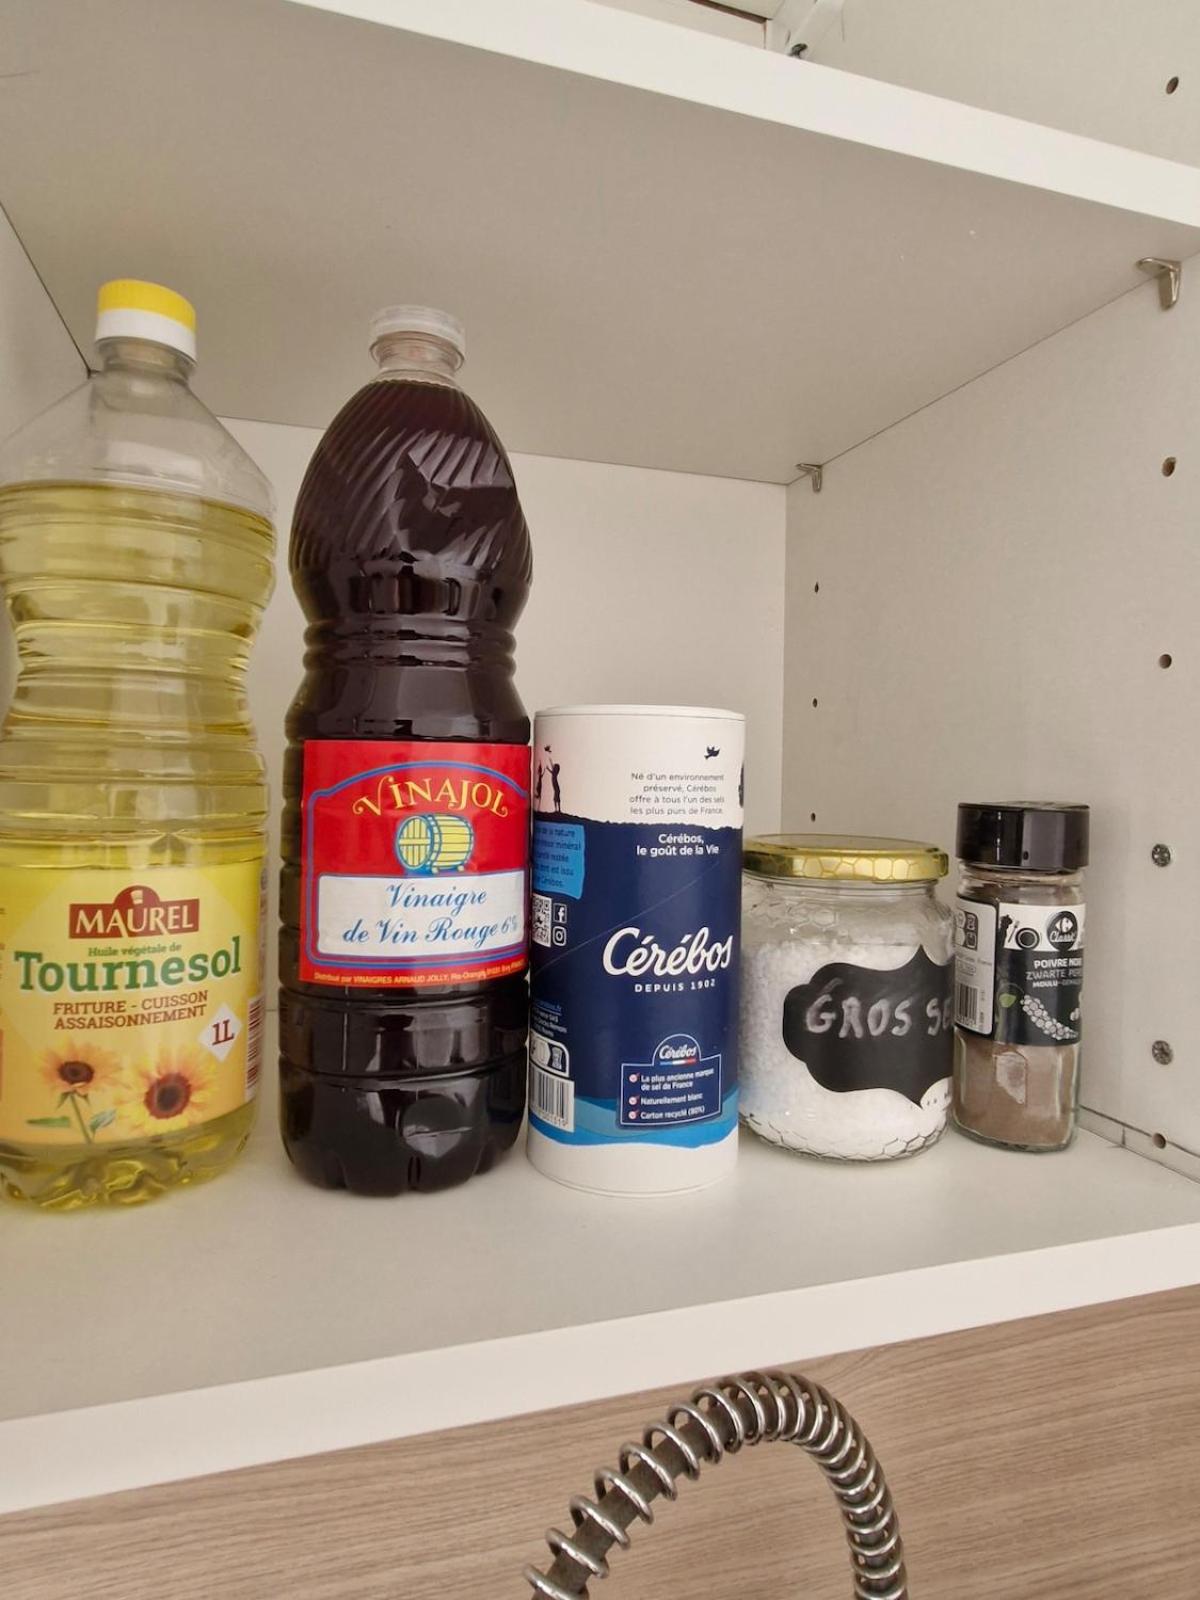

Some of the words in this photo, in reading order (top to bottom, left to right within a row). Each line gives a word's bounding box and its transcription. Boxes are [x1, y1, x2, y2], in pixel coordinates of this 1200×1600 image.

[629, 795, 651, 803] offre
[630, 807, 643, 815] les
[646, 807, 665, 815] plus
[688, 807, 699, 815] de
[658, 833, 705, 844] Cérébos,
[636, 845, 647, 855] le
[650, 845, 677, 858] goût
[680, 845, 693, 855] de
[695, 845, 704, 855] la
[705, 844, 720, 854] Vie
[386, 882, 487, 917] Vinaigre
[75, 905, 195, 937] MAUREL
[342, 918, 369, 943] de
[375, 918, 418, 944] Vin
[425, 916, 498, 948] Rouge
[88, 947, 119, 957] Huile
[121, 943, 167, 957] végétale
[168, 942, 182, 951] de
[602, 926, 734, 976] Cérébos
[14, 935, 242, 992] Tournesol
[1033, 958, 1068, 969] POIVRE
[1025, 969, 1066, 980] ZWARTE
[634, 982, 684, 993] DEPUIS
[690, 979, 716, 990] 1902
[53, 1000, 127, 1015] FRITURE
[141, 990, 209, 1011] CUISSON
[54, 1004, 207, 1030] ASSAISONNEMENT
[806, 994, 913, 1039] GROS
[211, 1019, 235, 1046] 1L
[658, 1044, 697, 1059] Cérébos
[651, 1074, 666, 1083] plus
[666, 1072, 694, 1081] ancienne
[641, 1083, 650, 1091] de
[651, 1083, 661, 1091] sel
[641, 1095, 687, 1105] Naturellement
[640, 1111, 663, 1119] Carton
